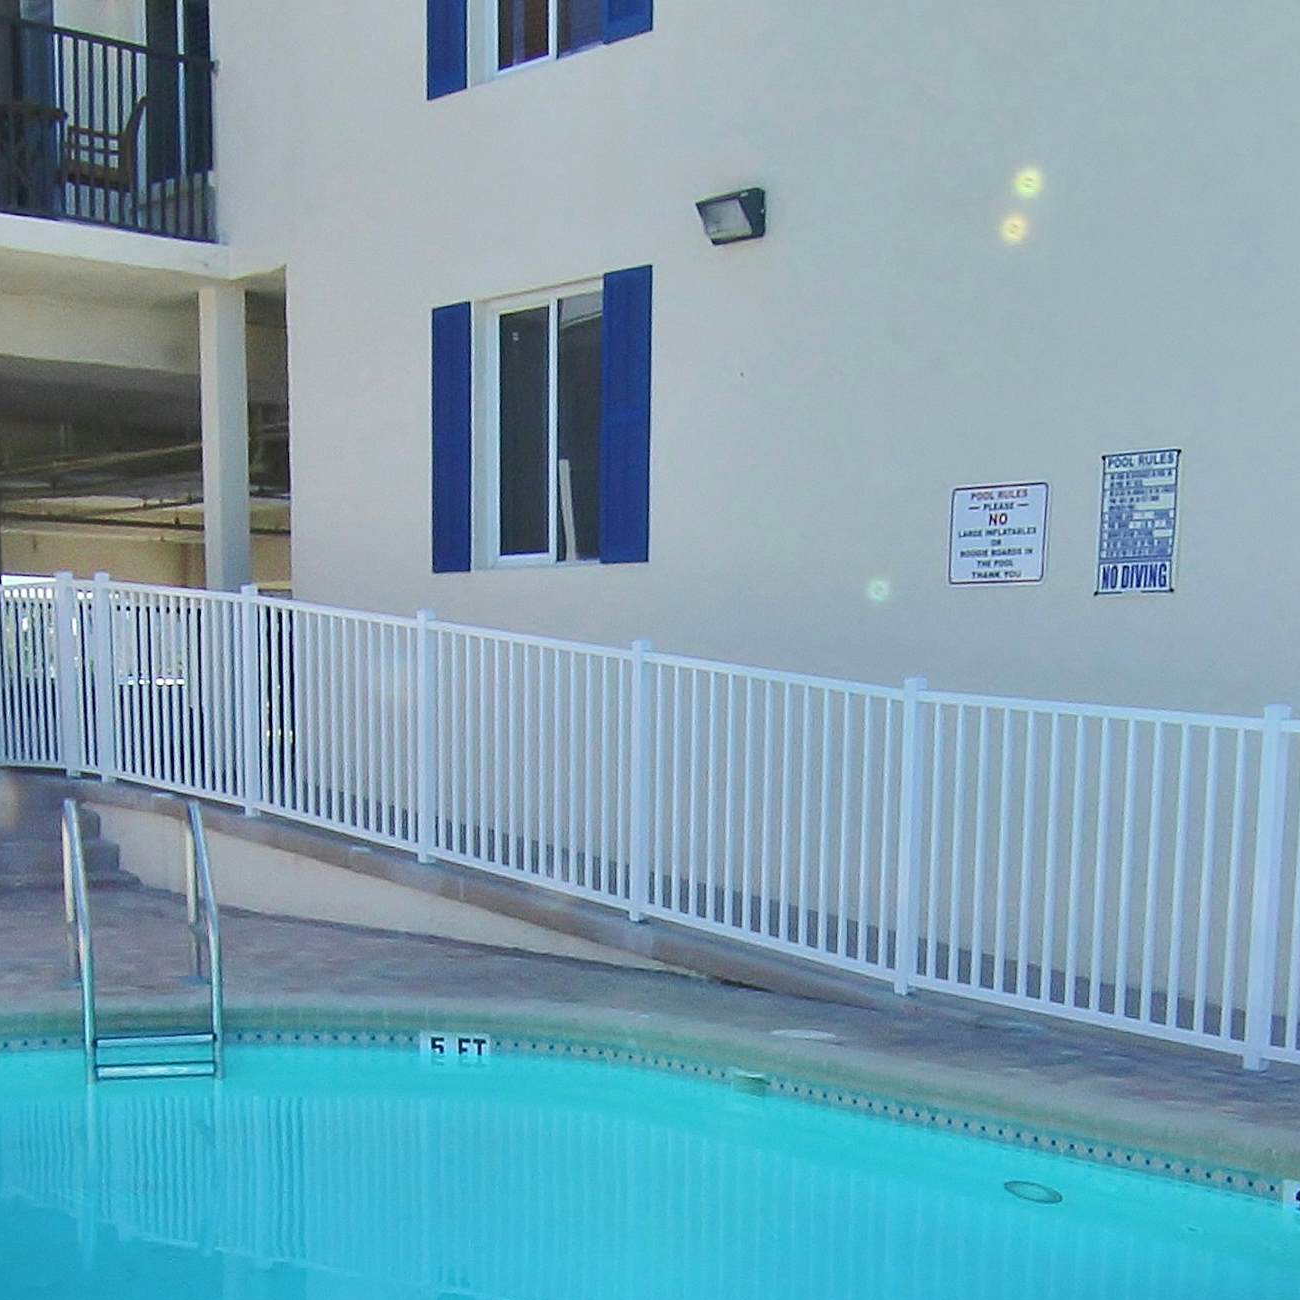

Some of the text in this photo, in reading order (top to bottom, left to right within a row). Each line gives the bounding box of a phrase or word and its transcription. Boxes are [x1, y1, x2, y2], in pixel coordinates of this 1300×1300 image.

[1107, 452, 1175, 469] POOL RULES
[971, 489, 1028, 501] POOL RULES
[982, 502, 1014, 511] PLEASE
[988, 513, 1008, 526] NO
[958, 527, 1037, 538] LARGE INFLATABLES
[1024, 547, 1033, 555] IN
[976, 559, 1014, 568] THE POOL
[972, 570, 1022, 579] THANK YOU
[1101, 562, 1168, 590] NO DIVING
[430, 1036, 486, 1056] 5 FT
